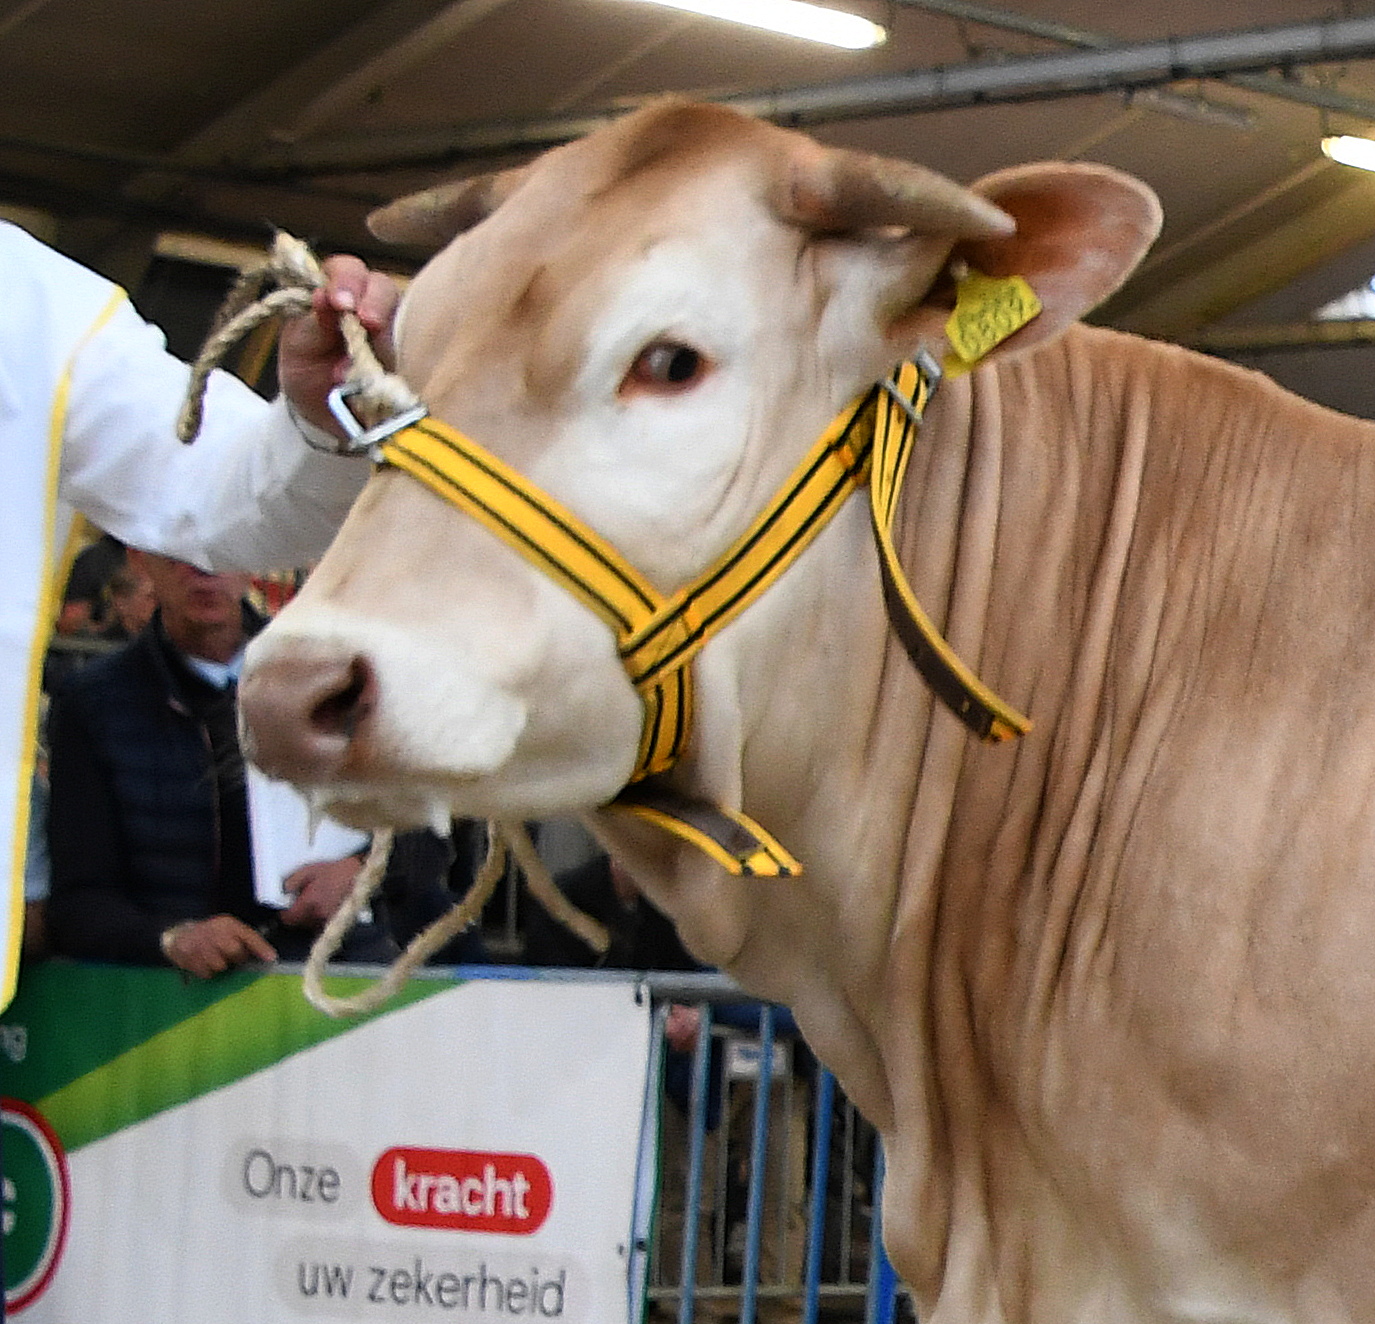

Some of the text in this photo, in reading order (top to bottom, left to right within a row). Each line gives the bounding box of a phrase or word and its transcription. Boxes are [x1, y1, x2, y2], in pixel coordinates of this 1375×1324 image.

[243, 1149, 531, 1219] Onze kracht
[298, 1257, 566, 1317] uw zekerheid
